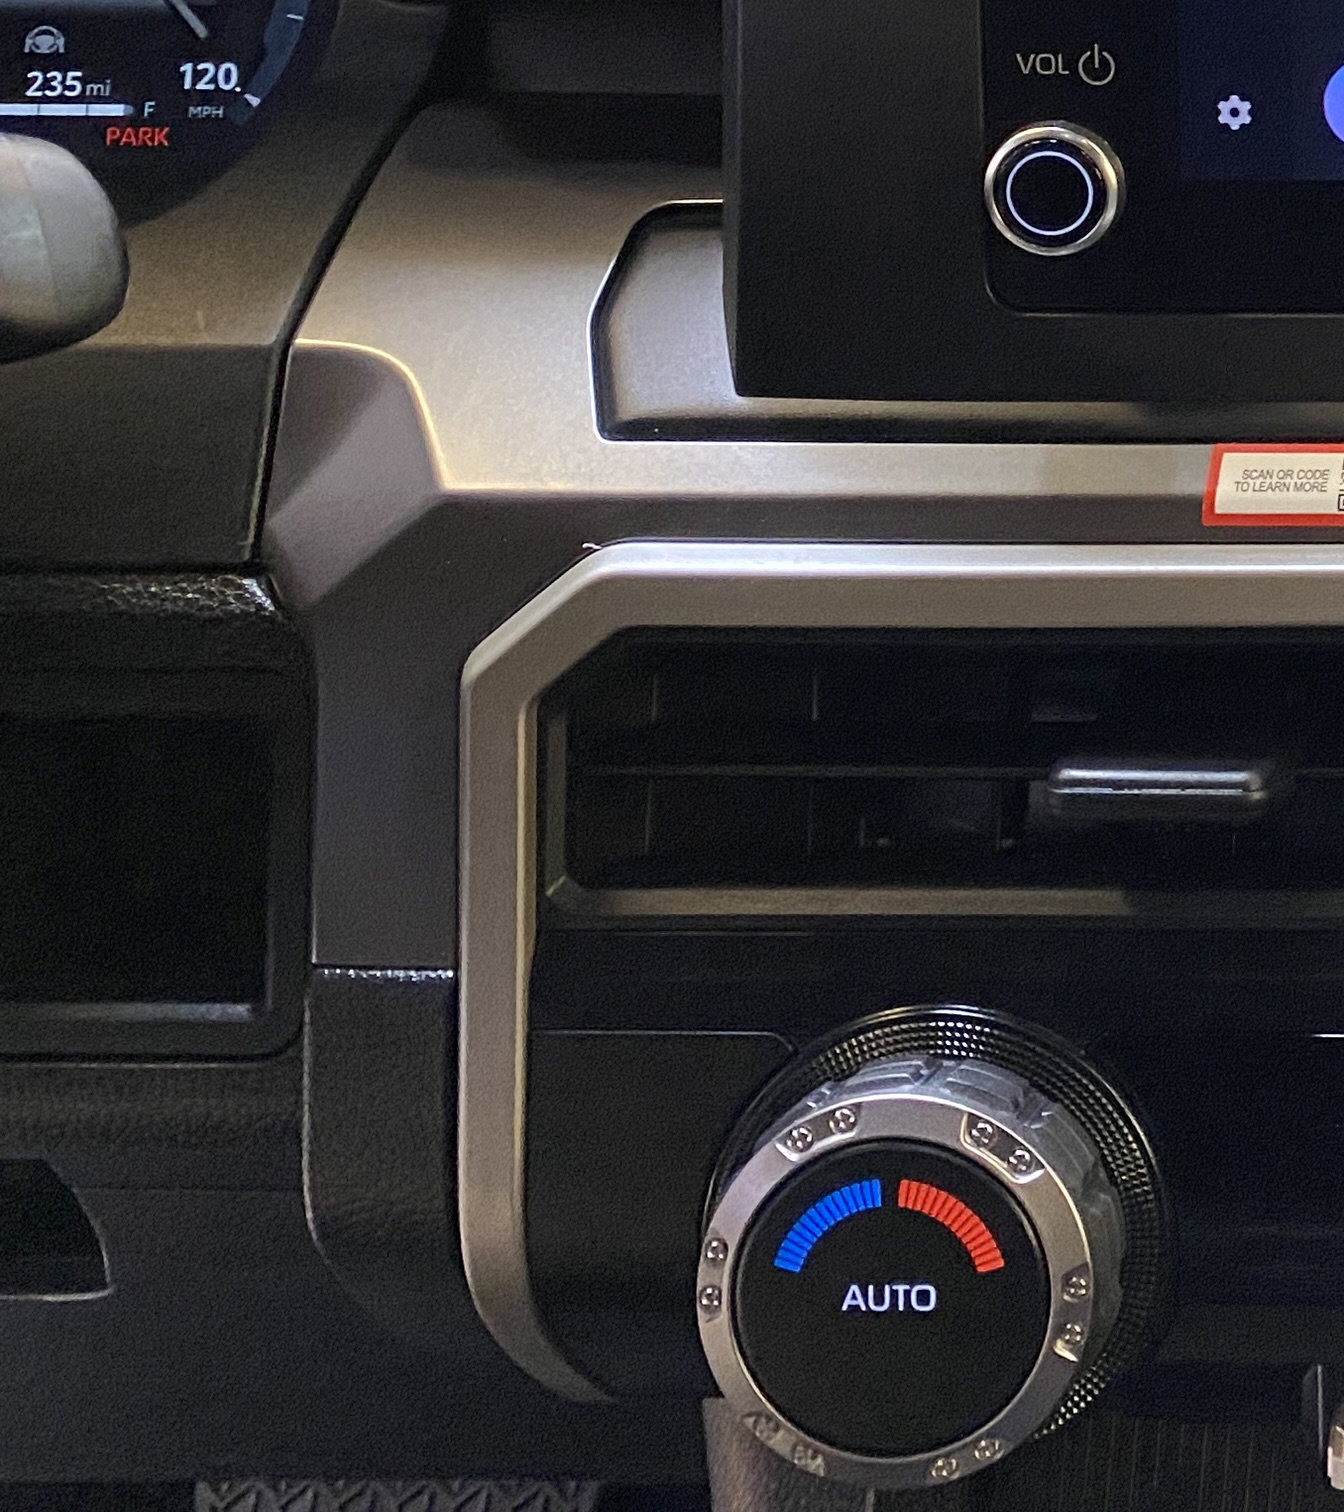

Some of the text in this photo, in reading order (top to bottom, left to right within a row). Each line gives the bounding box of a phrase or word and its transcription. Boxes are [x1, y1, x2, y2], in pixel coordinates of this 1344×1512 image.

[1016, 52, 1070, 76] VOL
[25, 71, 111, 97] 235 mi
[179, 62, 239, 90] 120
[143, 102, 156, 117] F
[188, 106, 224, 118] MPH
[106, 127, 170, 147] PARK
[1241, 469, 1274, 480] SCAN
[1296, 469, 1330, 481] CODE
[1234, 481, 1328, 492] TO LEARN MORE
[841, 1283, 937, 1313] AUTO
